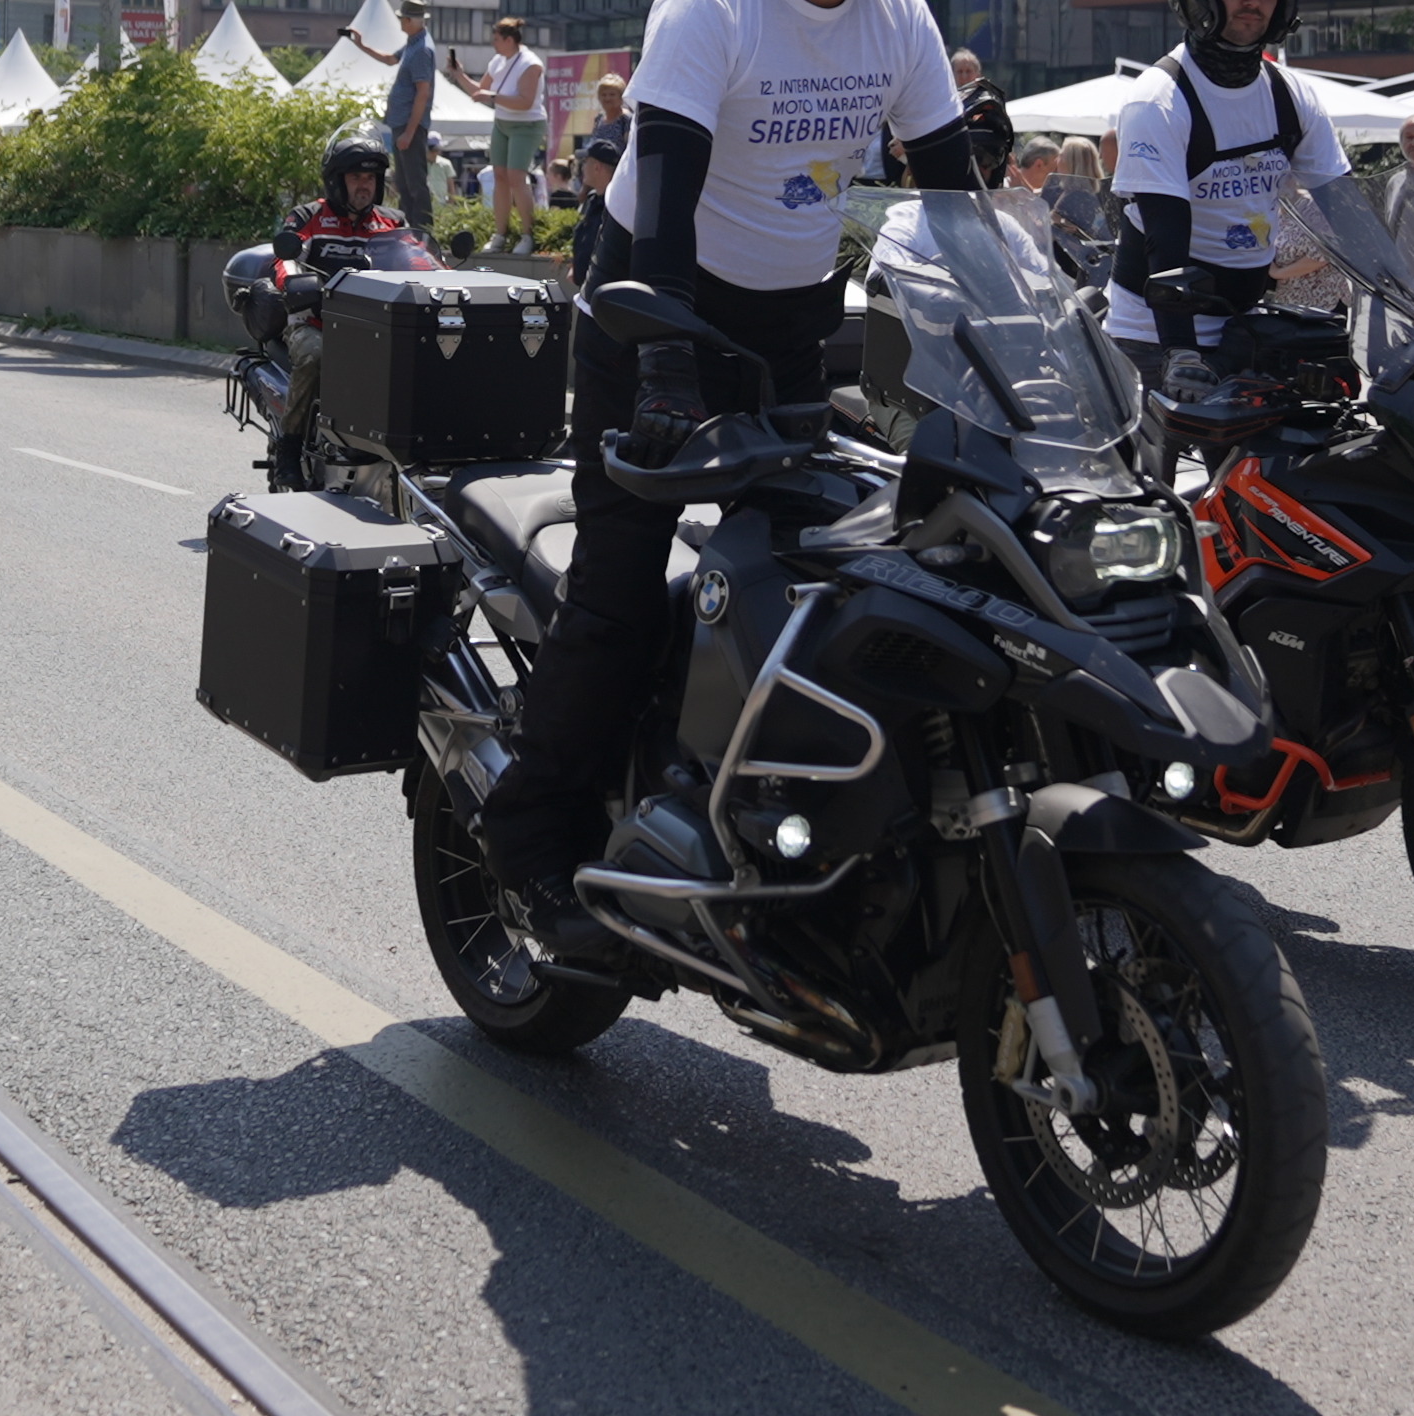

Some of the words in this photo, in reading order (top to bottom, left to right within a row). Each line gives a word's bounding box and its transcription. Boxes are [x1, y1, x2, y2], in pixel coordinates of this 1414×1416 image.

[779, 73, 892, 94] INTERNACIONALN
[772, 99, 813, 115] MOTO
[817, 94, 883, 112] MARATON
[749, 110, 883, 144] SREBRENIC
[1212, 166, 1242, 179] MOTO
[1248, 485, 1279, 508] SUPER
[1269, 507, 1349, 566] ADVENTURE
[1267, 630, 1305, 651] KTM
